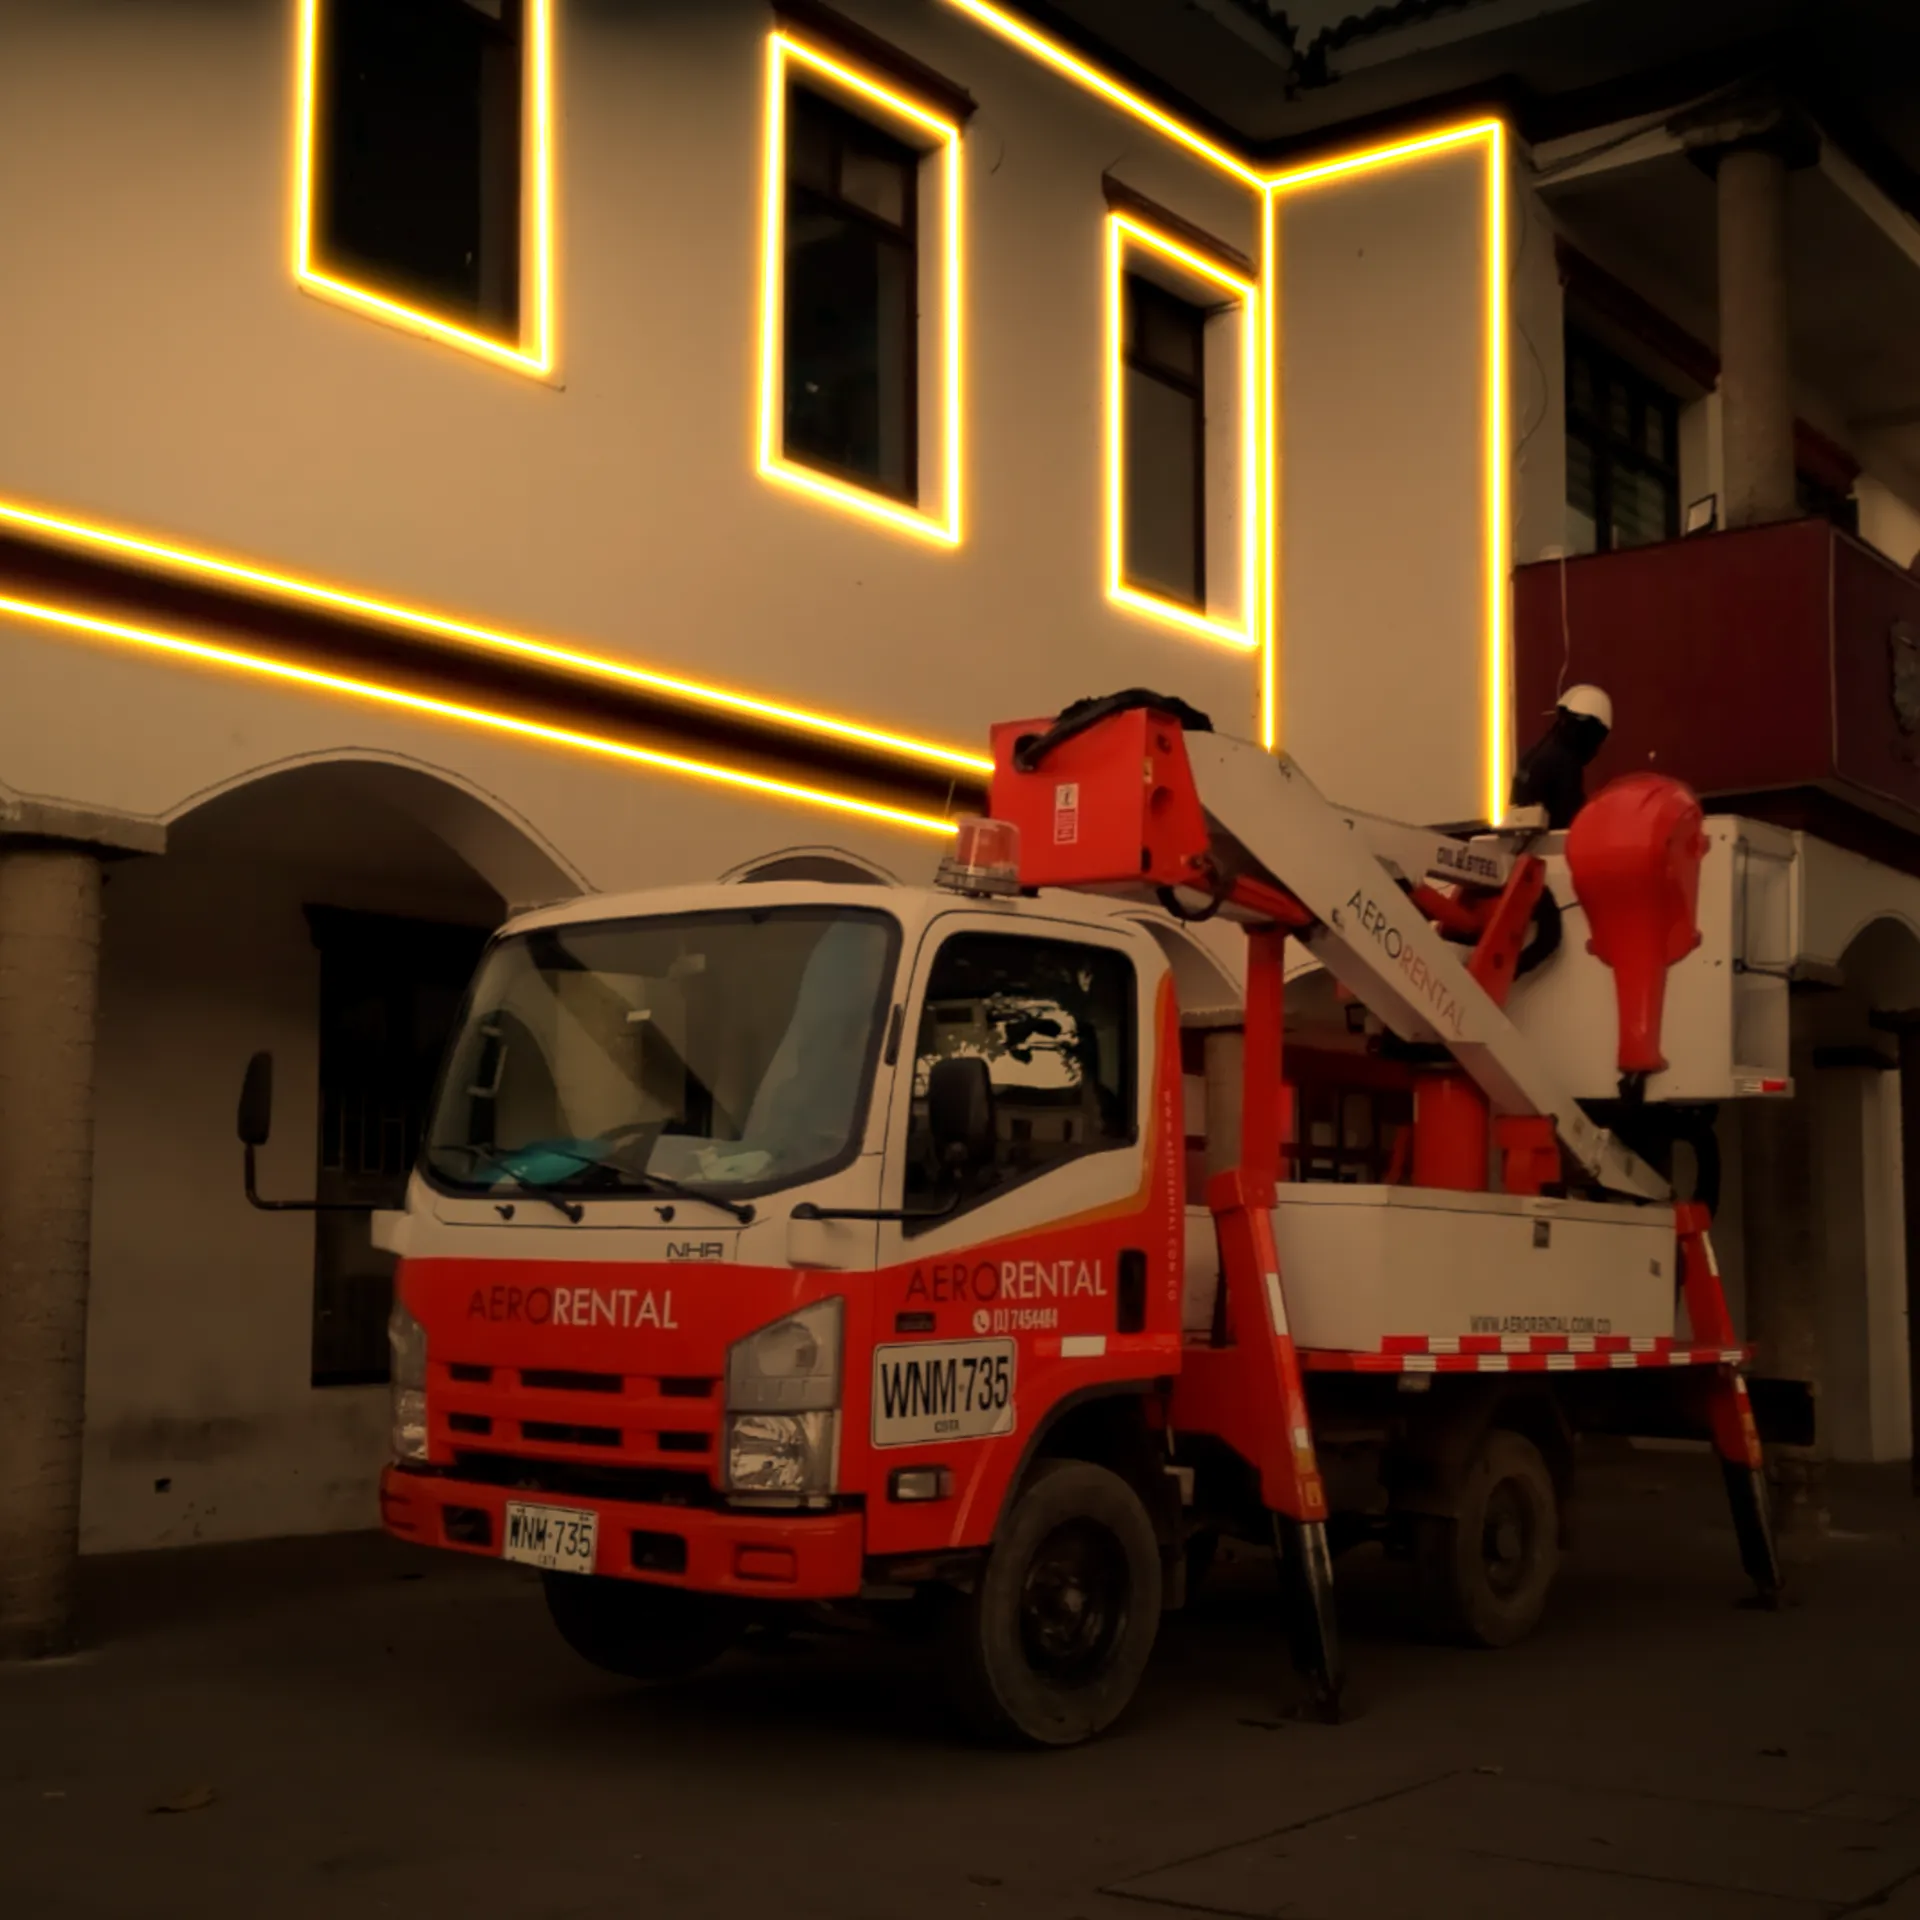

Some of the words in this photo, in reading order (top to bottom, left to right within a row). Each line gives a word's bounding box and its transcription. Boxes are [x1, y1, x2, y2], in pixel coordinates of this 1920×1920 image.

[1347, 889, 1466, 1037] AERORENTAL
[666, 1242, 723, 1258] NHR
[906, 1259, 1108, 1302] AERORENTAL
[467, 1285, 679, 1330] AERORENTAL
